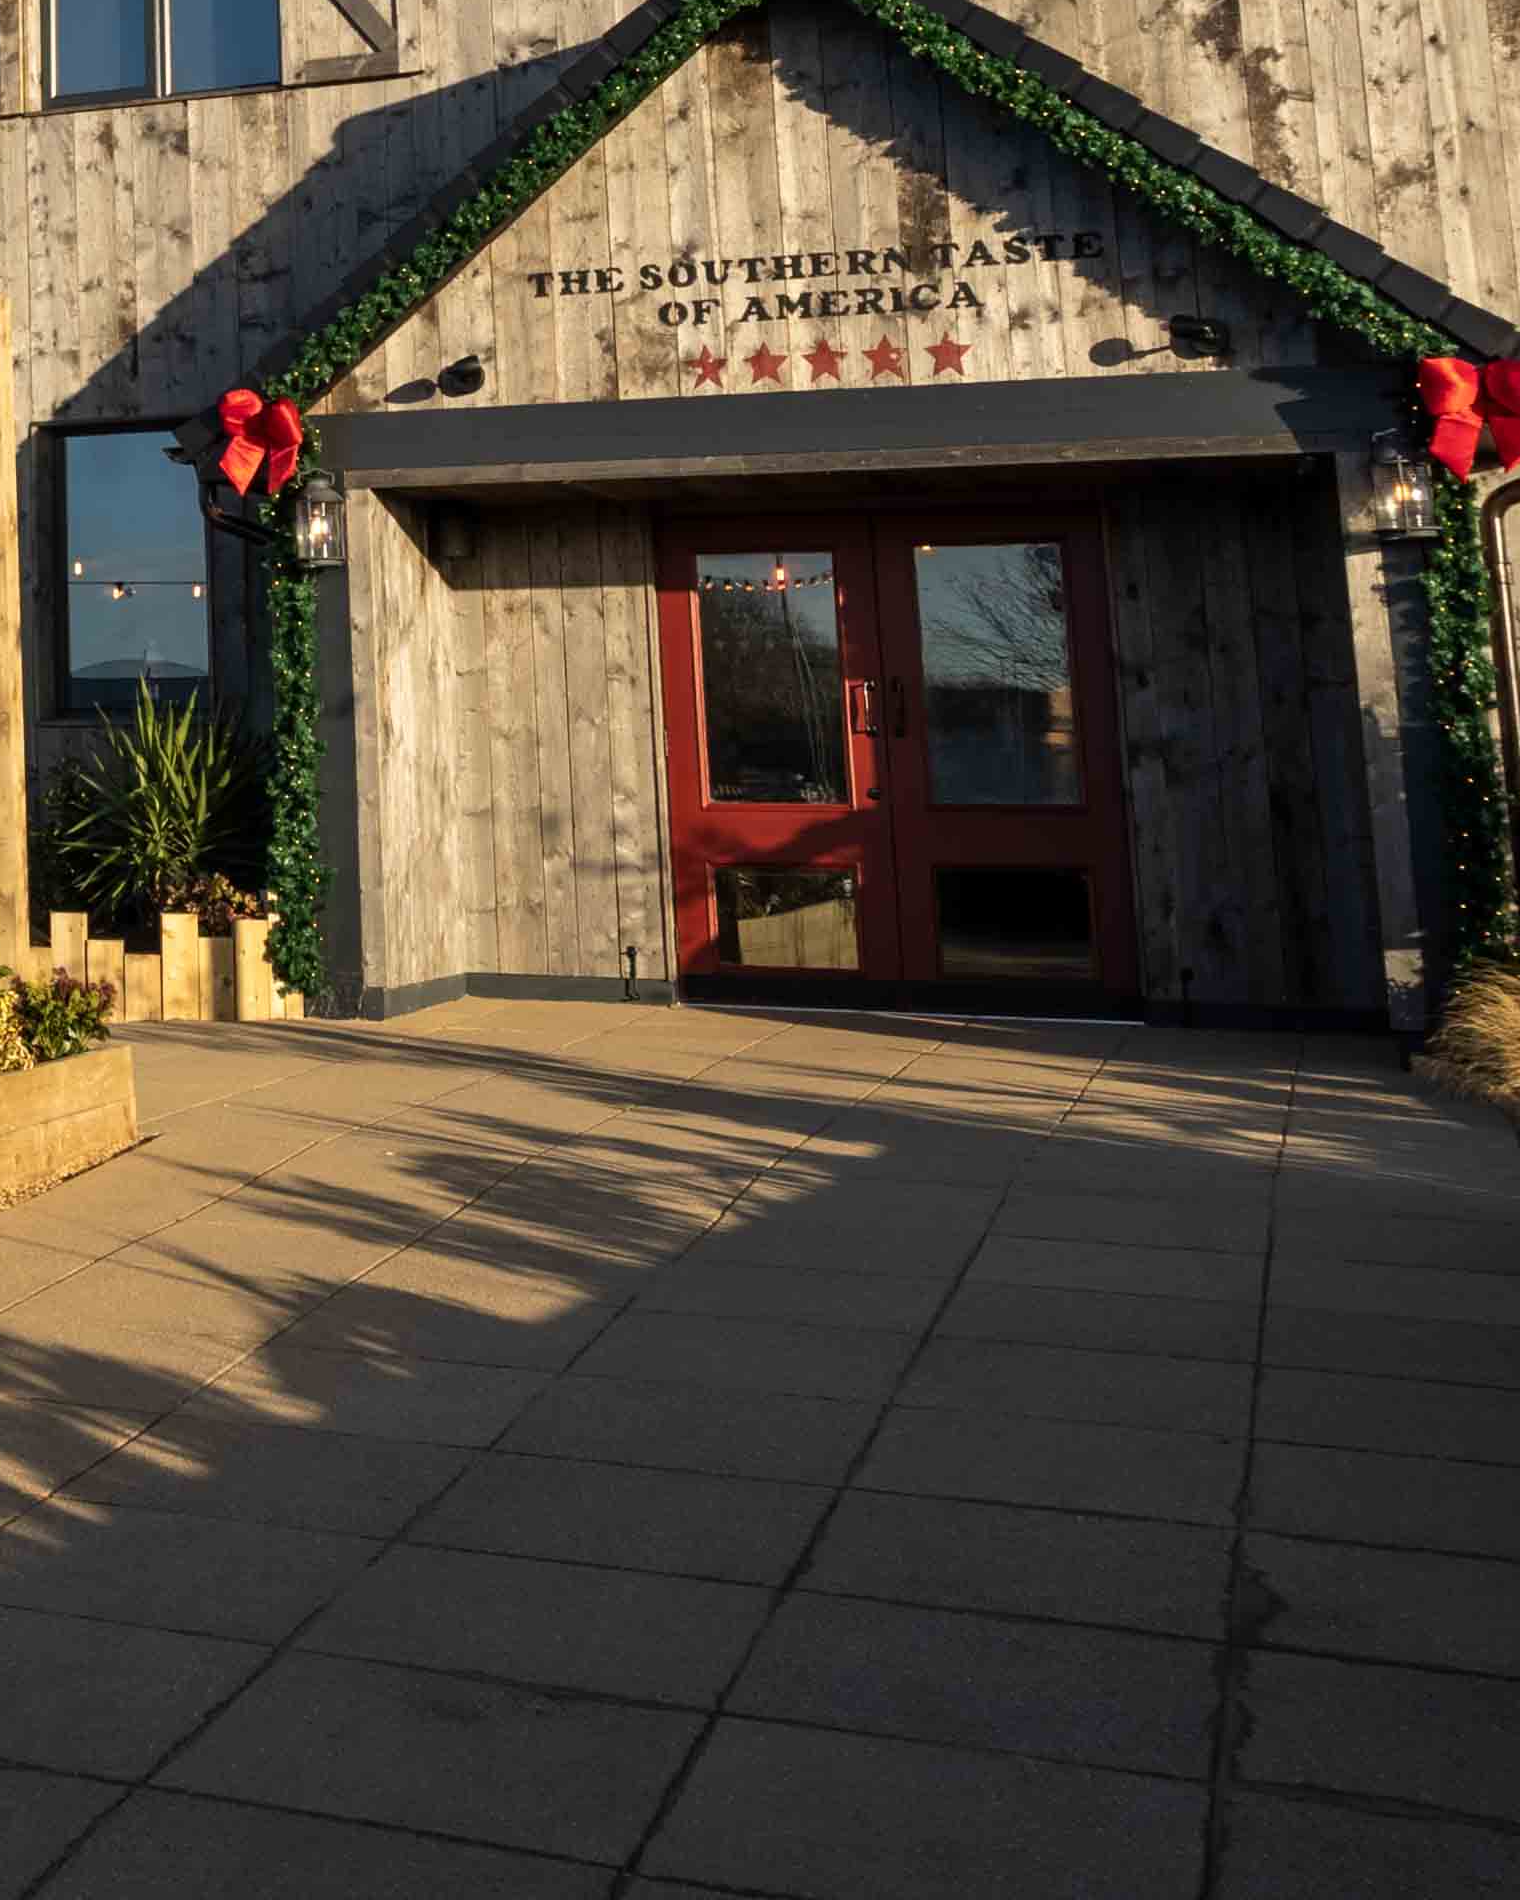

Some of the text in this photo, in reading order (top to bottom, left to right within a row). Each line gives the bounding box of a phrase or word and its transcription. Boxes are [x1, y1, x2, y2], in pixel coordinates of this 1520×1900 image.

[527, 232, 1106, 298] THE SOUTHERN TASTE
[658, 281, 984, 327] OF AMERICA
